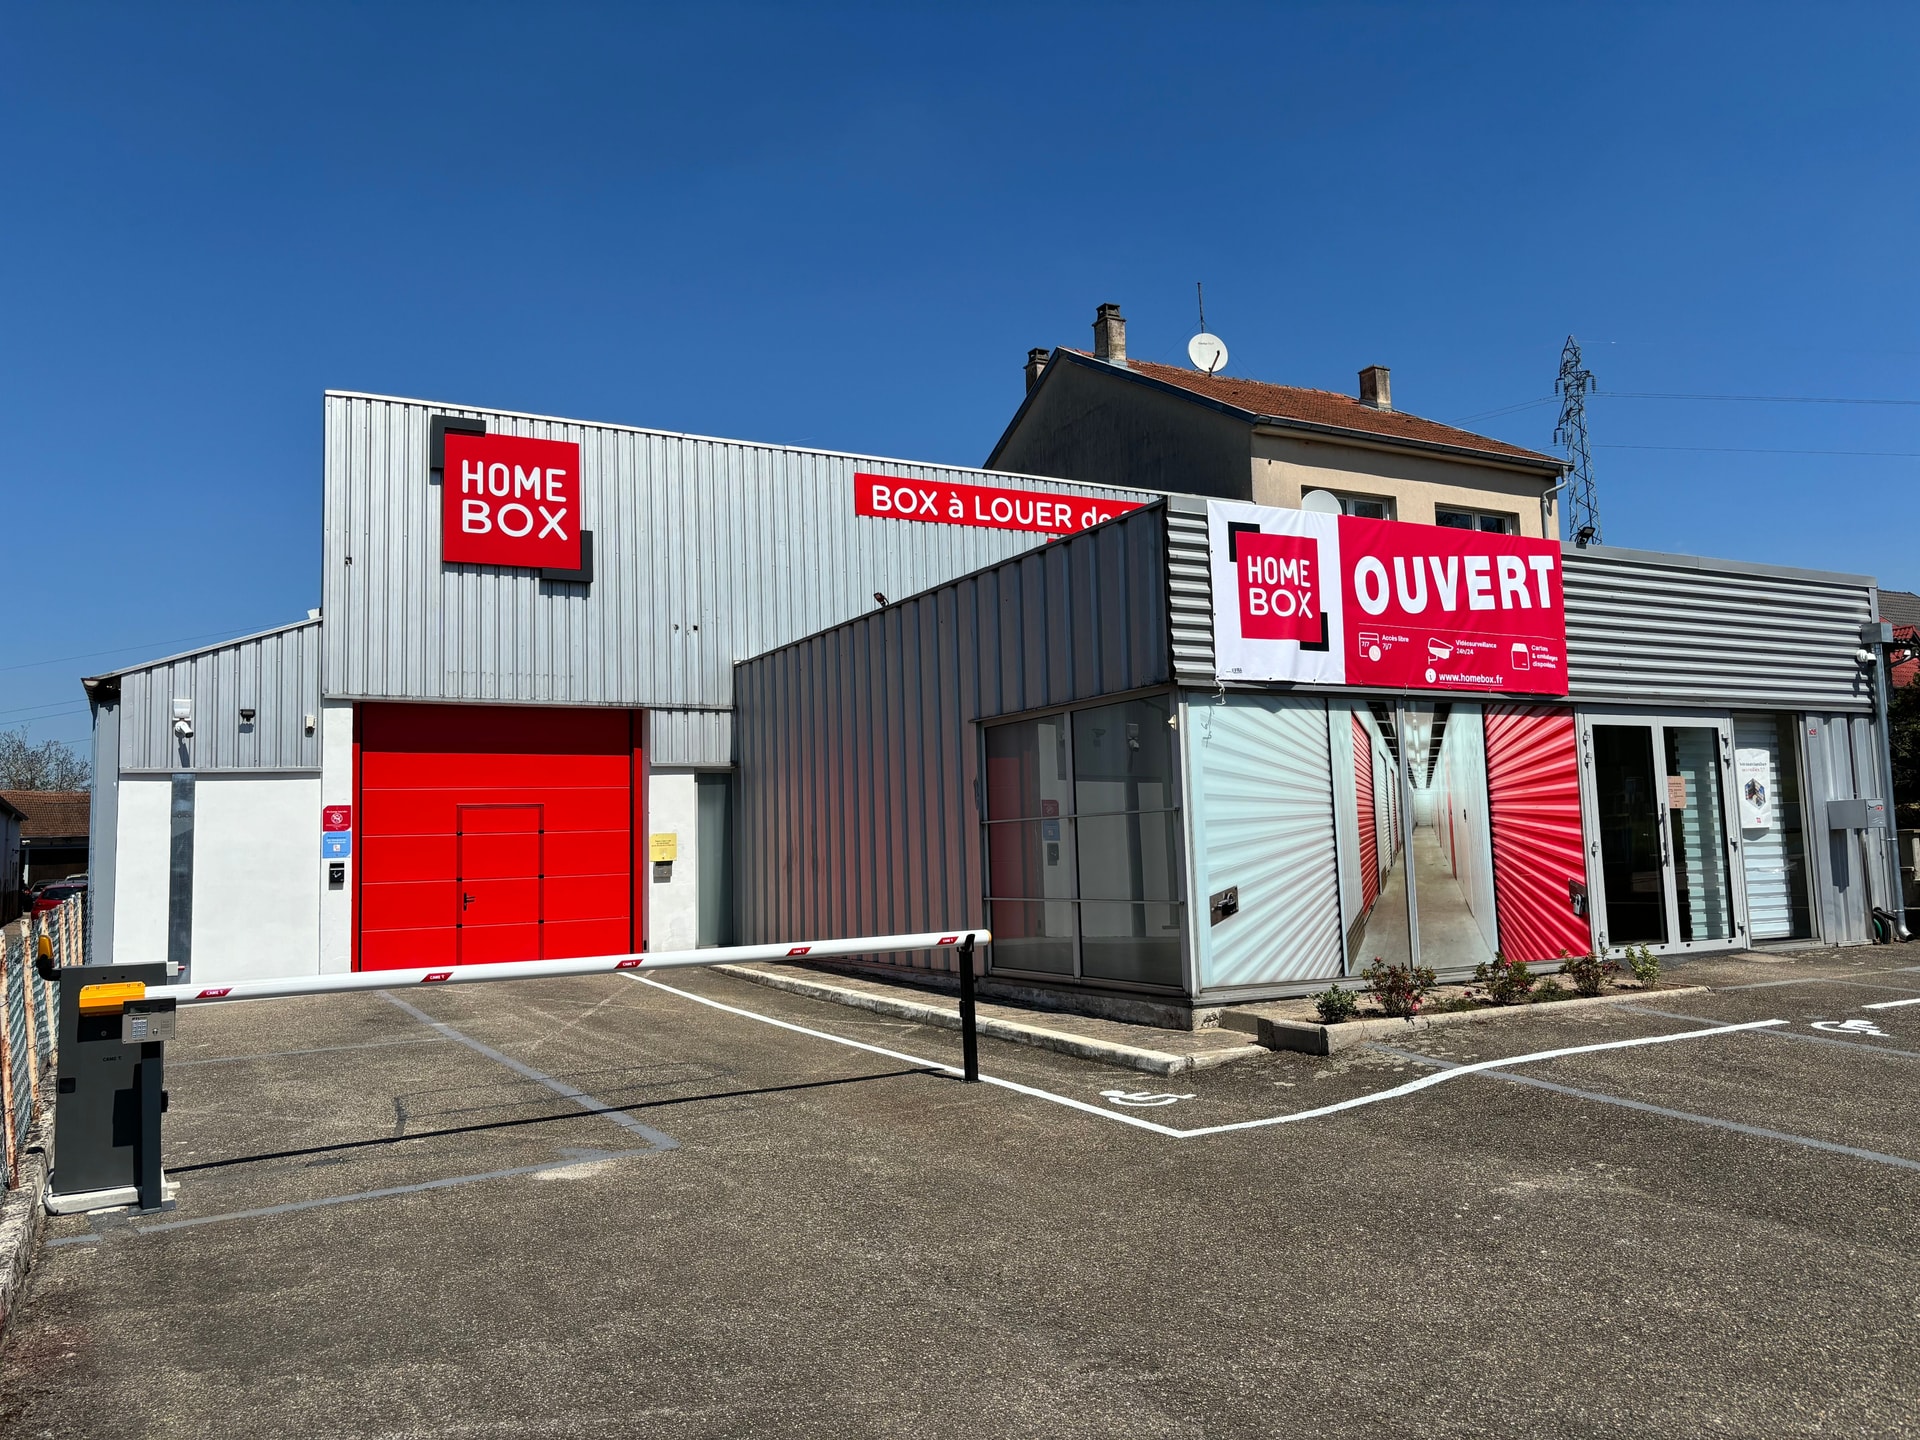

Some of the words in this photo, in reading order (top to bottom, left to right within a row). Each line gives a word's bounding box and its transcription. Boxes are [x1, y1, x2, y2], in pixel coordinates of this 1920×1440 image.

[461, 459, 567, 503] HOME
[461, 498, 568, 541] BOX
[871, 484, 939, 516] BOX
[948, 490, 964, 519] à
[974, 495, 1072, 529] LOUER
[1247, 555, 1311, 588] HOME
[1354, 555, 1555, 616] OUVERT
[1249, 588, 1313, 619] BOX
[1439, 673, 1504, 684] www.homebox.fr
